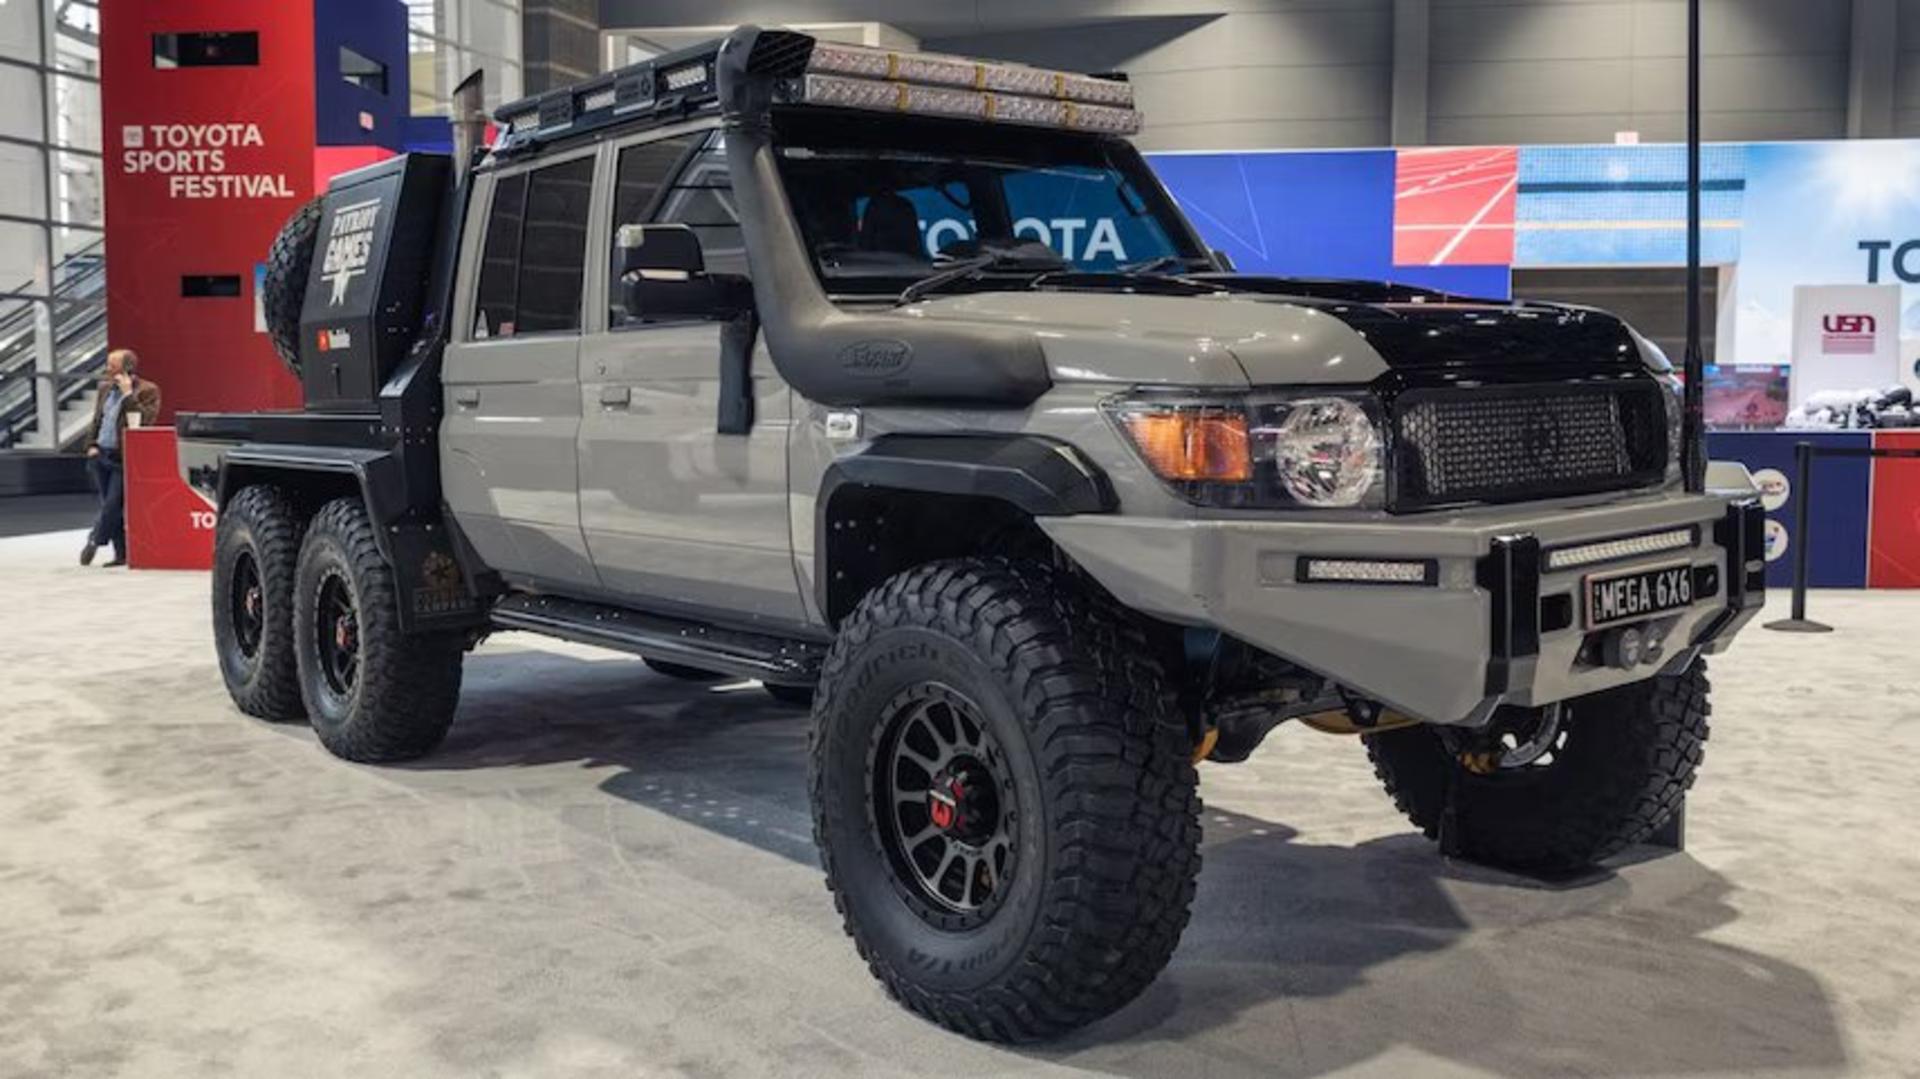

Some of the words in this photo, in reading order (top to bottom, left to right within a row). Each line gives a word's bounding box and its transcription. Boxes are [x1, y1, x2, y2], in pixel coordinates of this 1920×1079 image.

[151, 124, 264, 147] TOYOTA
[123, 150, 226, 173] SPORTS
[170, 174, 295, 198] FESTIVAL
[917, 217, 1128, 262] OOTA
[190, 511, 217, 529] TO
[1601, 576, 1652, 618] MEGA
[1656, 568, 1690, 608] 6X6
